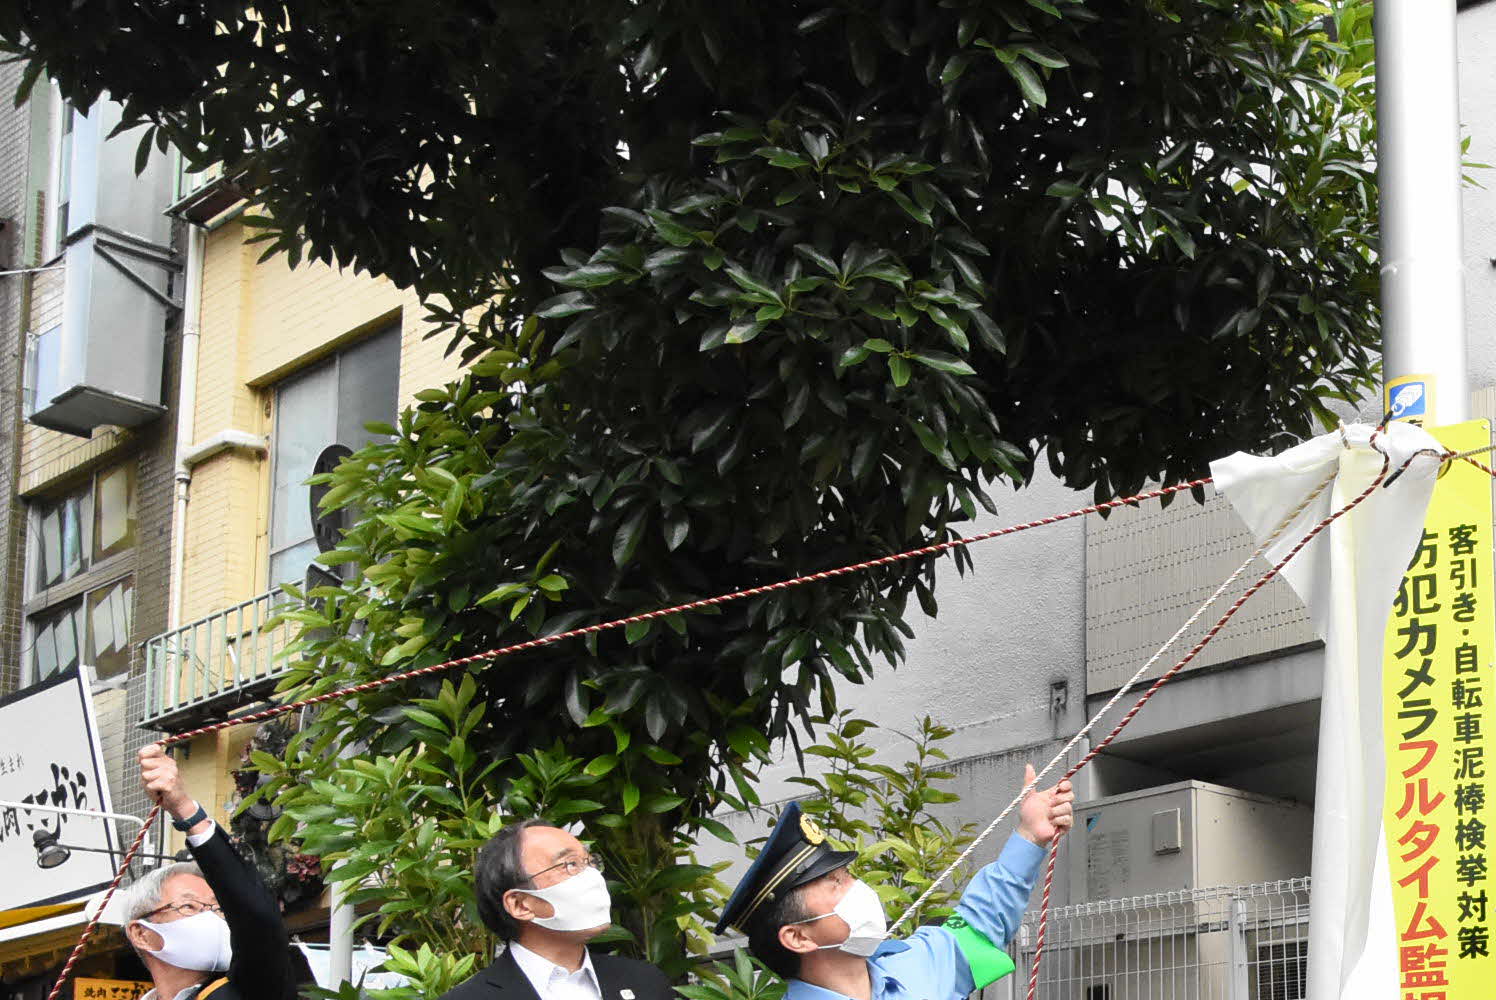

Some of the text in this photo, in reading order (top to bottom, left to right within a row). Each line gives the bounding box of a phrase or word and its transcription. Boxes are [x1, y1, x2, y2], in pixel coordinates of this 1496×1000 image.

[1448, 523, 1490, 960] 客引き・自転車泥棒検挙対策
